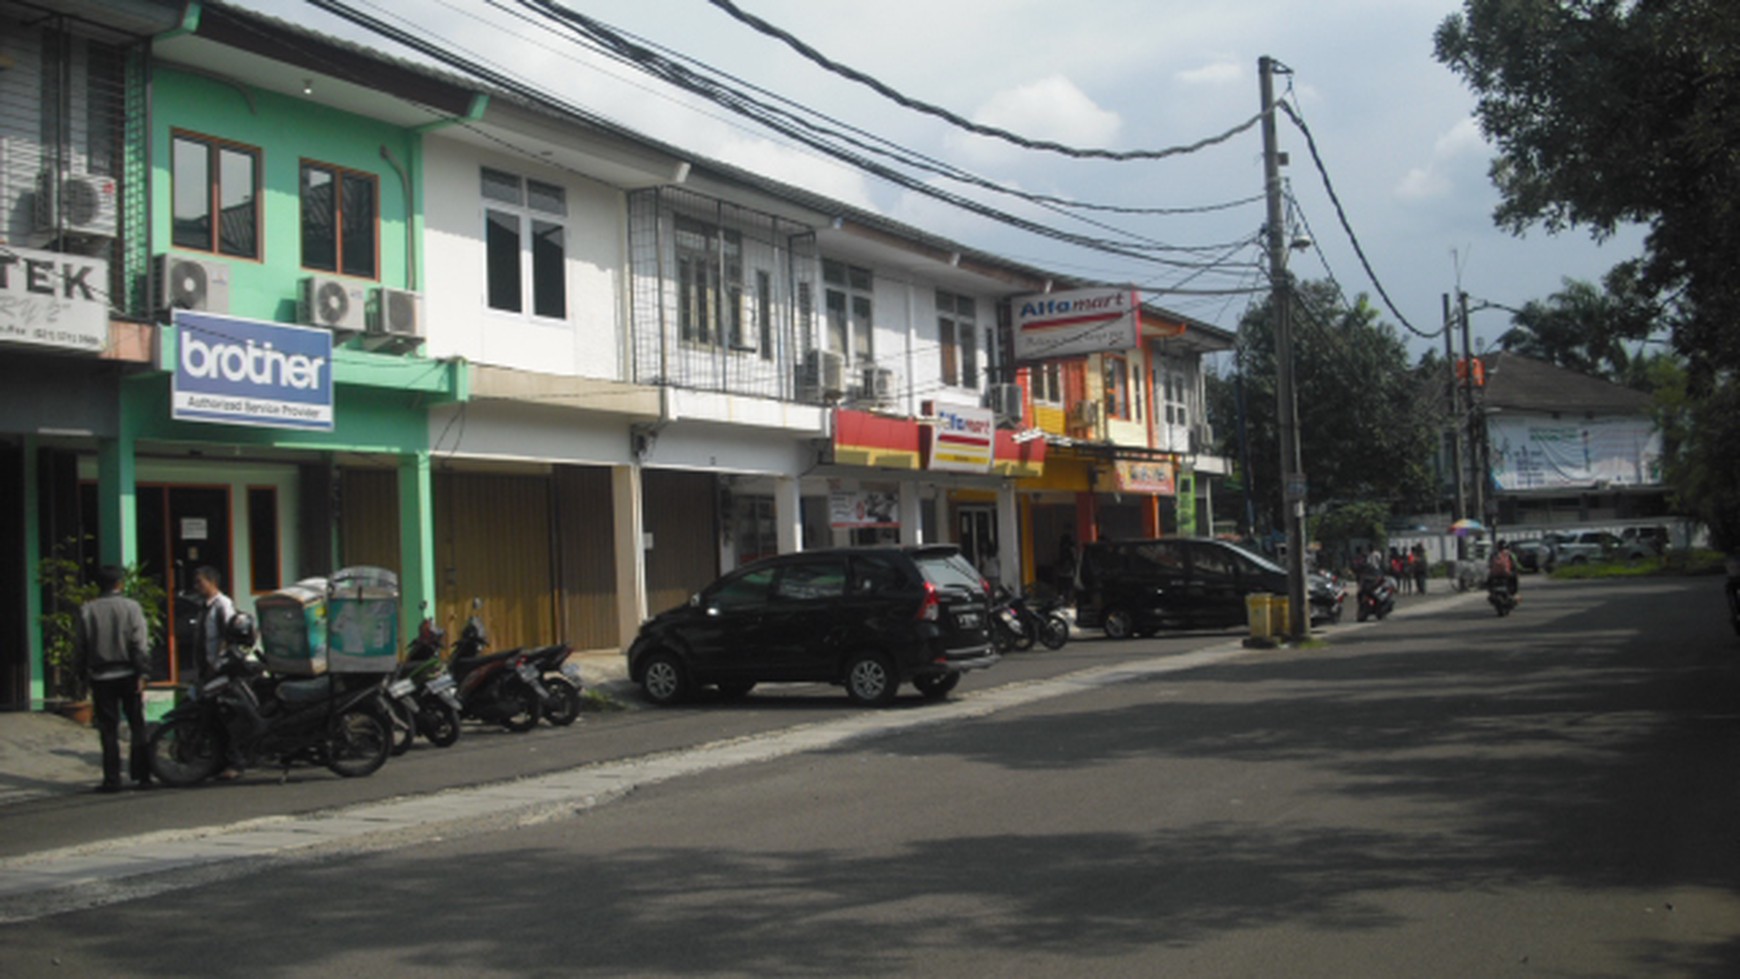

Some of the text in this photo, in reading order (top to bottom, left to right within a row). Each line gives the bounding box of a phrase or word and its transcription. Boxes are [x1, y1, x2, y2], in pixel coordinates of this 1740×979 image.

[1021, 293, 1124, 317] Alfamart
[181, 331, 325, 390] brother
[188, 396, 320, 418] Authorized Service Provider
